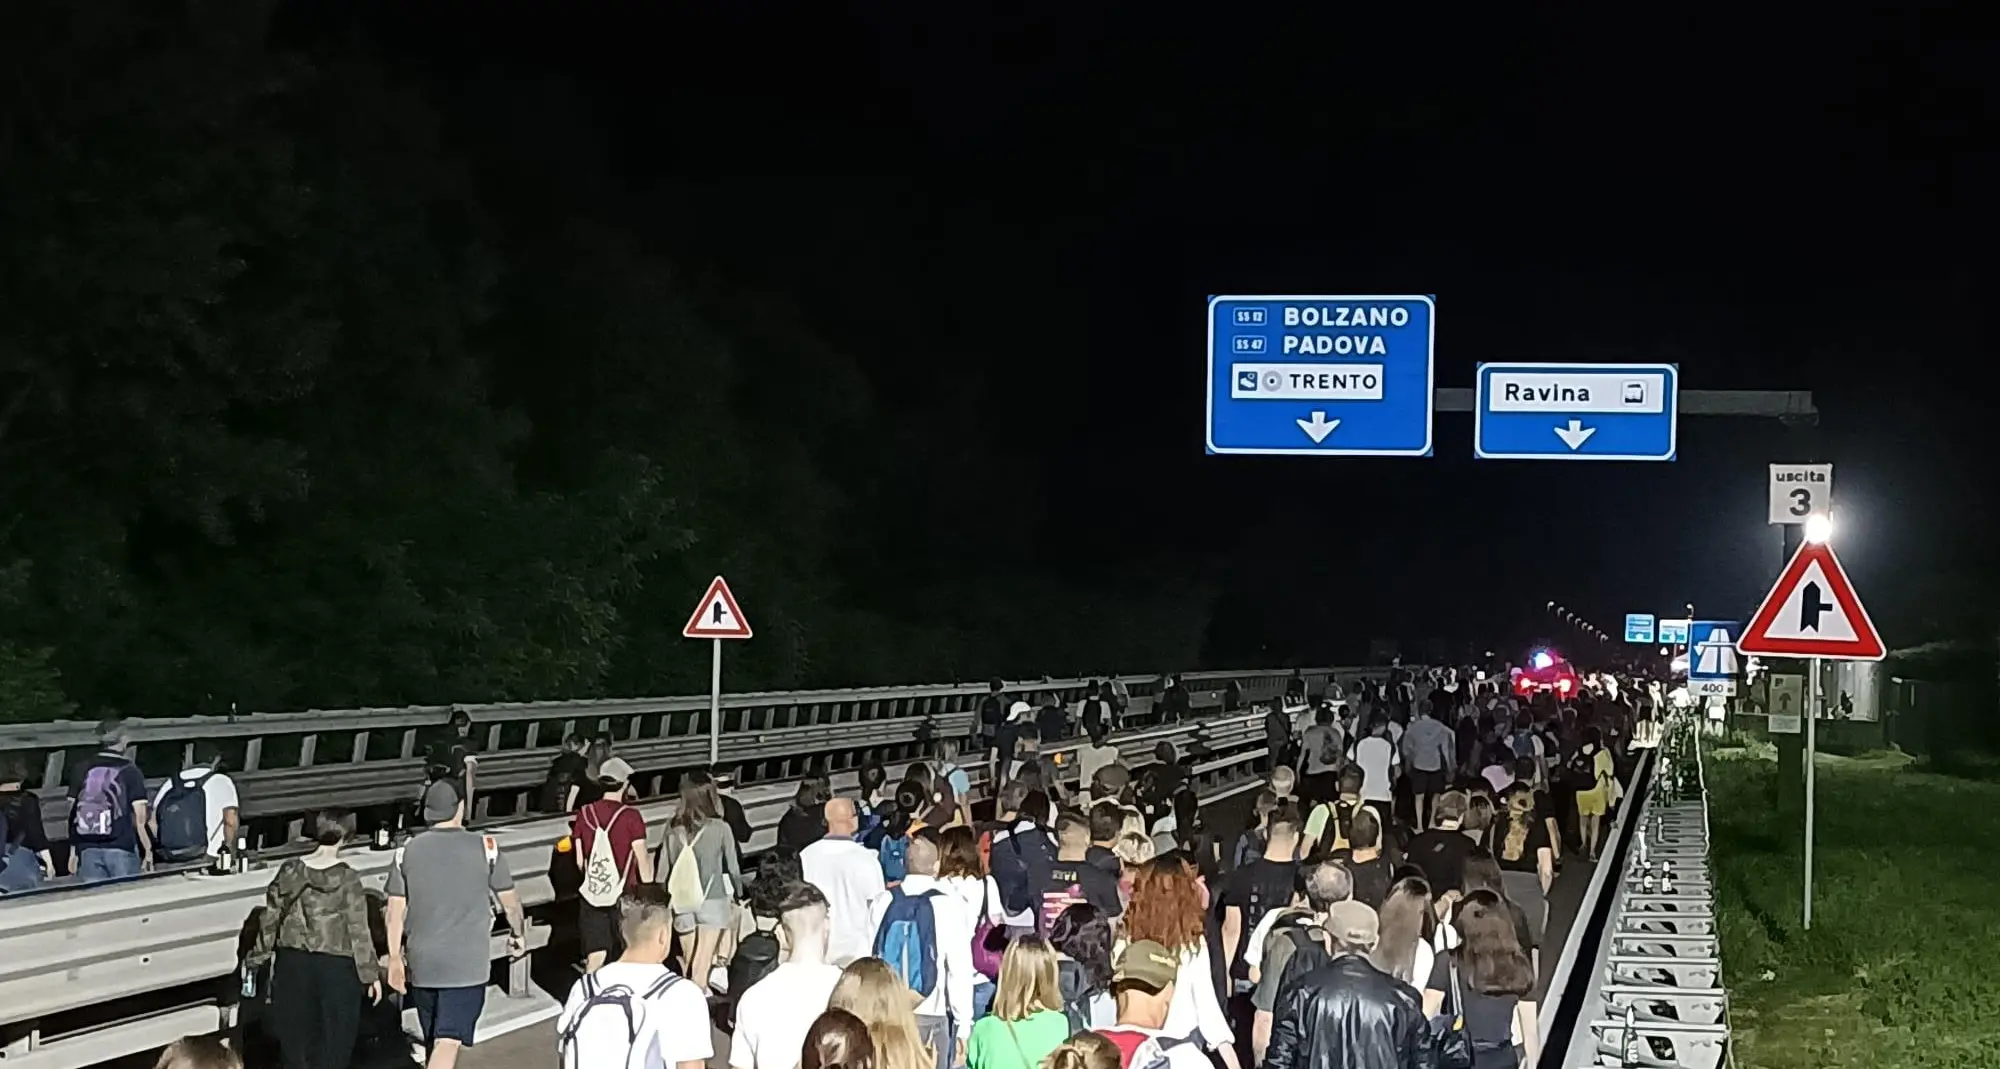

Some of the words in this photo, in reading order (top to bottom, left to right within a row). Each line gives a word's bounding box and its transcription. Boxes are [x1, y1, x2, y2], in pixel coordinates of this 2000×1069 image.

[1238, 311, 1250, 321] SS
[1283, 307, 1409, 327] BOLZANO
[1236, 339, 1249, 350] SS
[1283, 335, 1387, 355] PADOVA
[1289, 373, 1378, 390] TRENTO
[1505, 383, 1590, 402] Ravina
[1776, 470, 1825, 482] uscita
[1789, 488, 1811, 516] 3
[1701, 683, 1724, 693] 400
